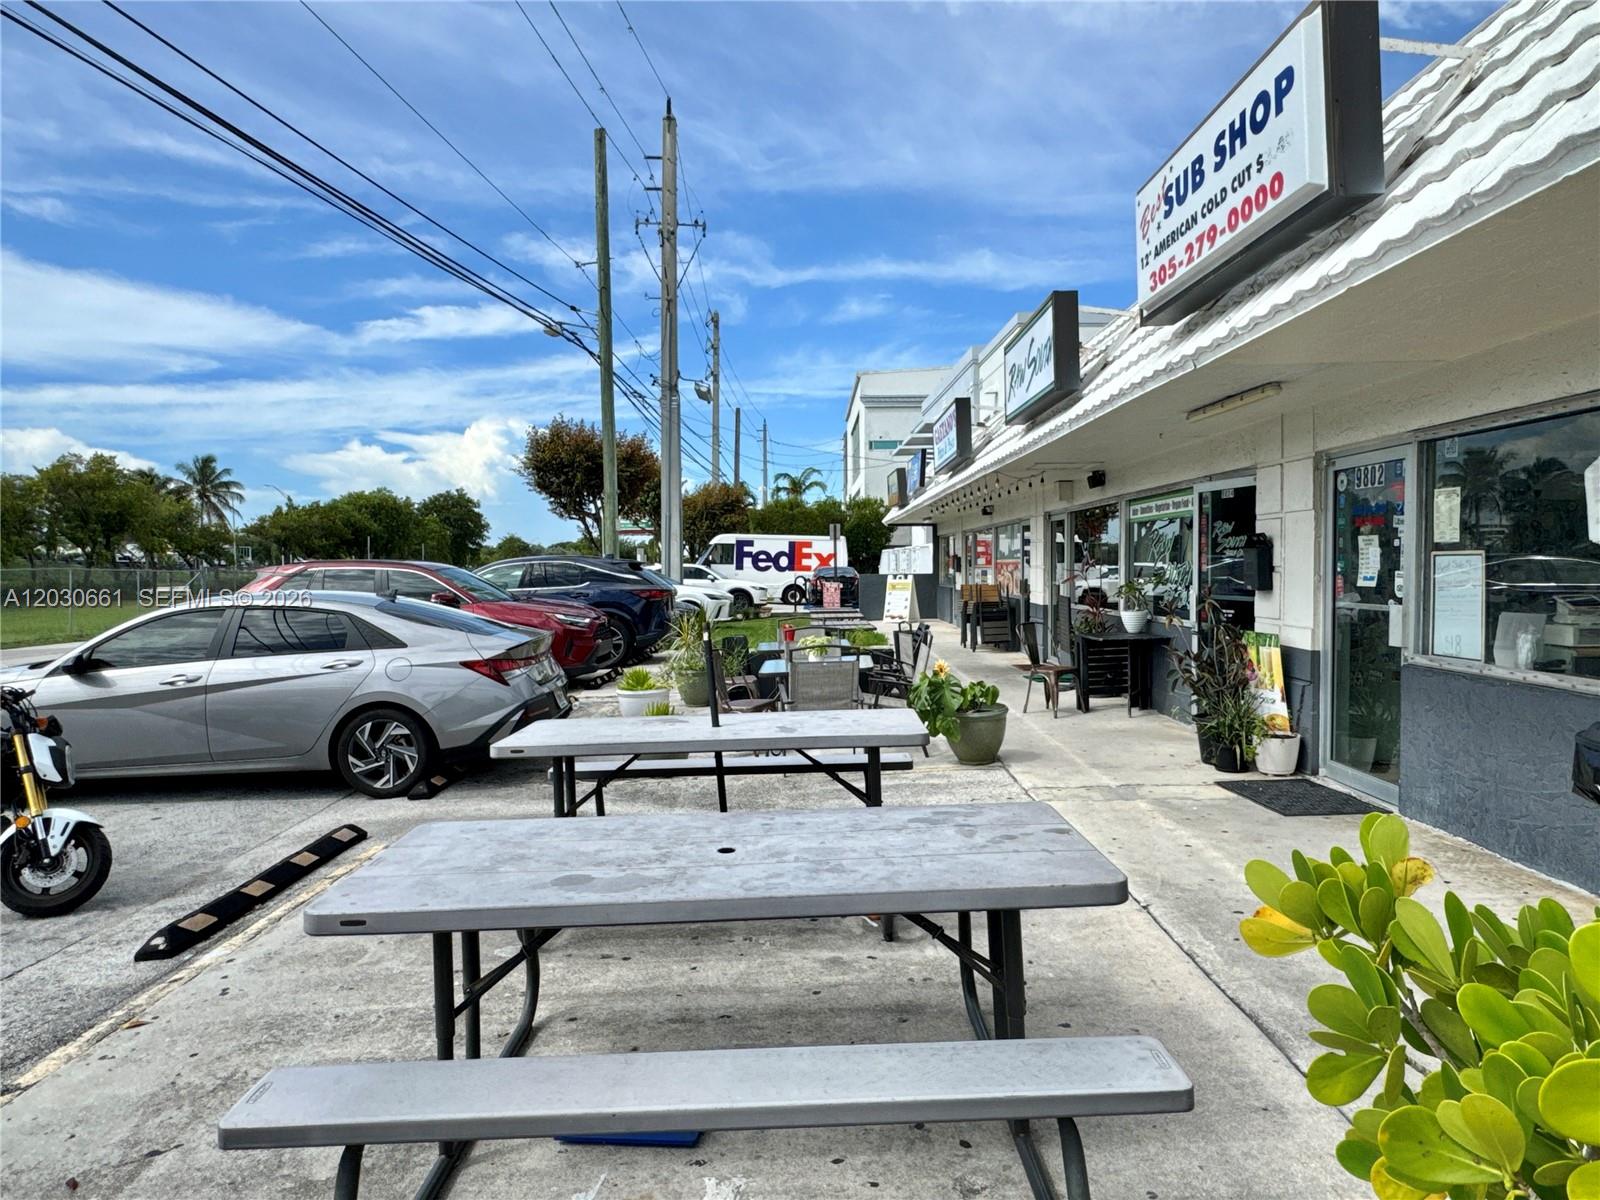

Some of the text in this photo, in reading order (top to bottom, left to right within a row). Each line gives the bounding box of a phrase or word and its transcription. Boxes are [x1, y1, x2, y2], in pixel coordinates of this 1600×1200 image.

[1163, 153, 1206, 220] SUB
[1213, 65, 1295, 173] SHOP
[1149, 170, 1284, 293] 305-279-0000
[1153, 210, 1199, 260] AMERICAN
[1200, 185, 1228, 220] COLD
[1230, 162, 1253, 195] CUT
[1356, 464, 1384, 488] 9802
[735, 540, 837, 573] FedEx
